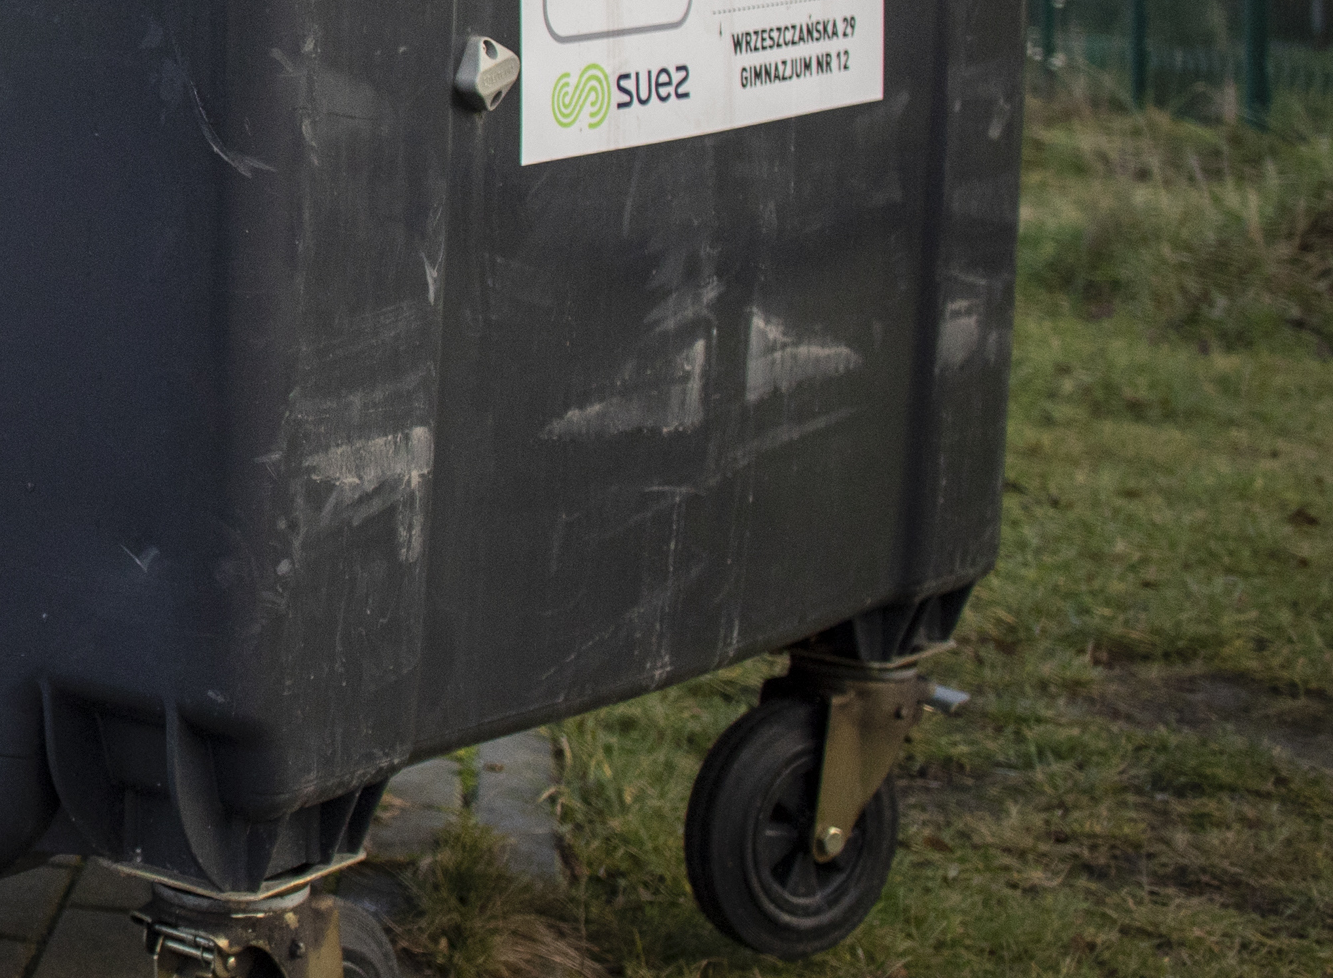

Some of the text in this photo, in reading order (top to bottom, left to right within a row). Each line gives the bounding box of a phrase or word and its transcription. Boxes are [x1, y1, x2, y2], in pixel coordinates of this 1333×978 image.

[731, 14, 856, 56] WRZESZCZAŃSKA 29
[617, 65, 690, 109] suez
[741, 49, 850, 88] GIMNAZJUM NR 12
